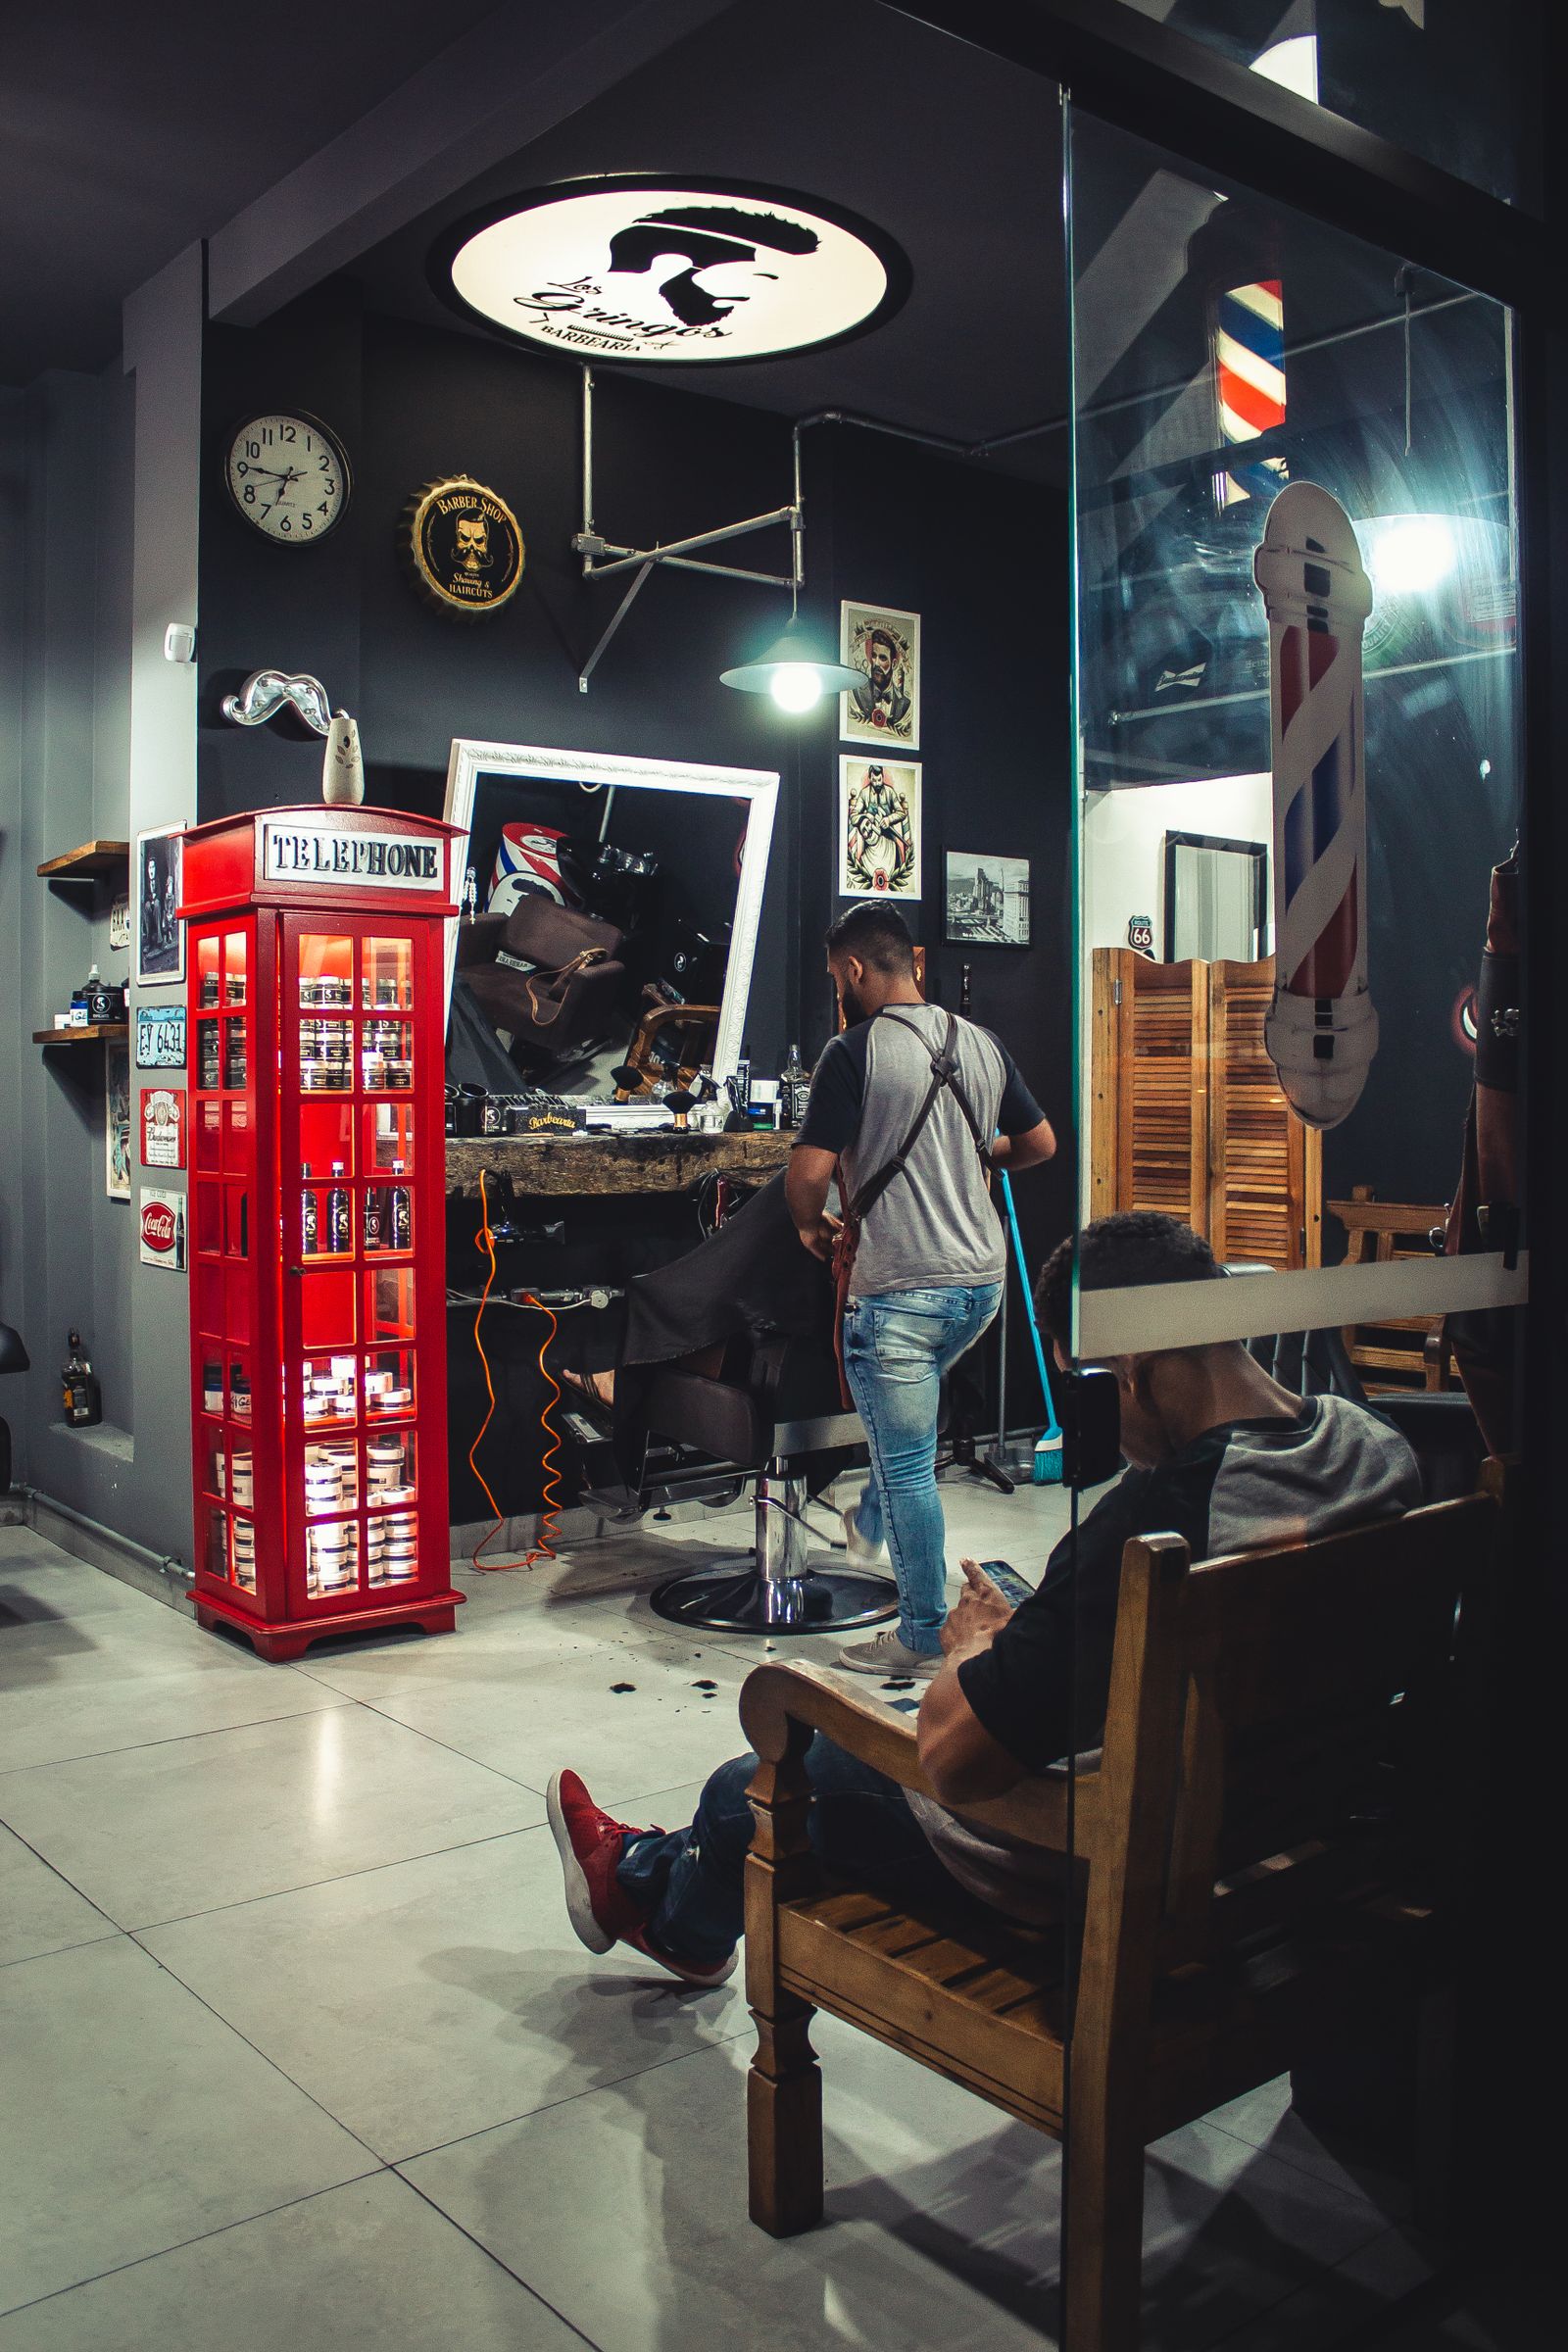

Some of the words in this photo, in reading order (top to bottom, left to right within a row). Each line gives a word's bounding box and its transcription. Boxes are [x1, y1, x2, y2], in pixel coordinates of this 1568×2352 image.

[547, 276, 602, 295] Los
[514, 291, 733, 338] Gringos
[541, 325, 641, 352] BARBEARIA
[263, 427, 272, 446] 11
[280, 423, 296, 443] 12
[246, 440, 260, 459] 10
[307, 435, 311, 452] 1
[237, 462, 248, 478] 9
[318, 455, 330, 472] 2
[244, 484, 256, 504] 8
[324, 478, 335, 496] 3
[261, 503, 271, 520] 7
[318, 501, 329, 516] 4
[436, 496, 477, 515] BARBER
[481, 497, 508, 523] SHOP
[280, 514, 292, 532] 6
[302, 513, 313, 530] 5
[453, 572, 483, 589] Shaving
[449, 584, 493, 599] HAIRCUTS
[273, 834, 438, 879] TELEPHONE
[1134, 928, 1151, 945] 66
[529, 1111, 576, 1130] Barbearia
